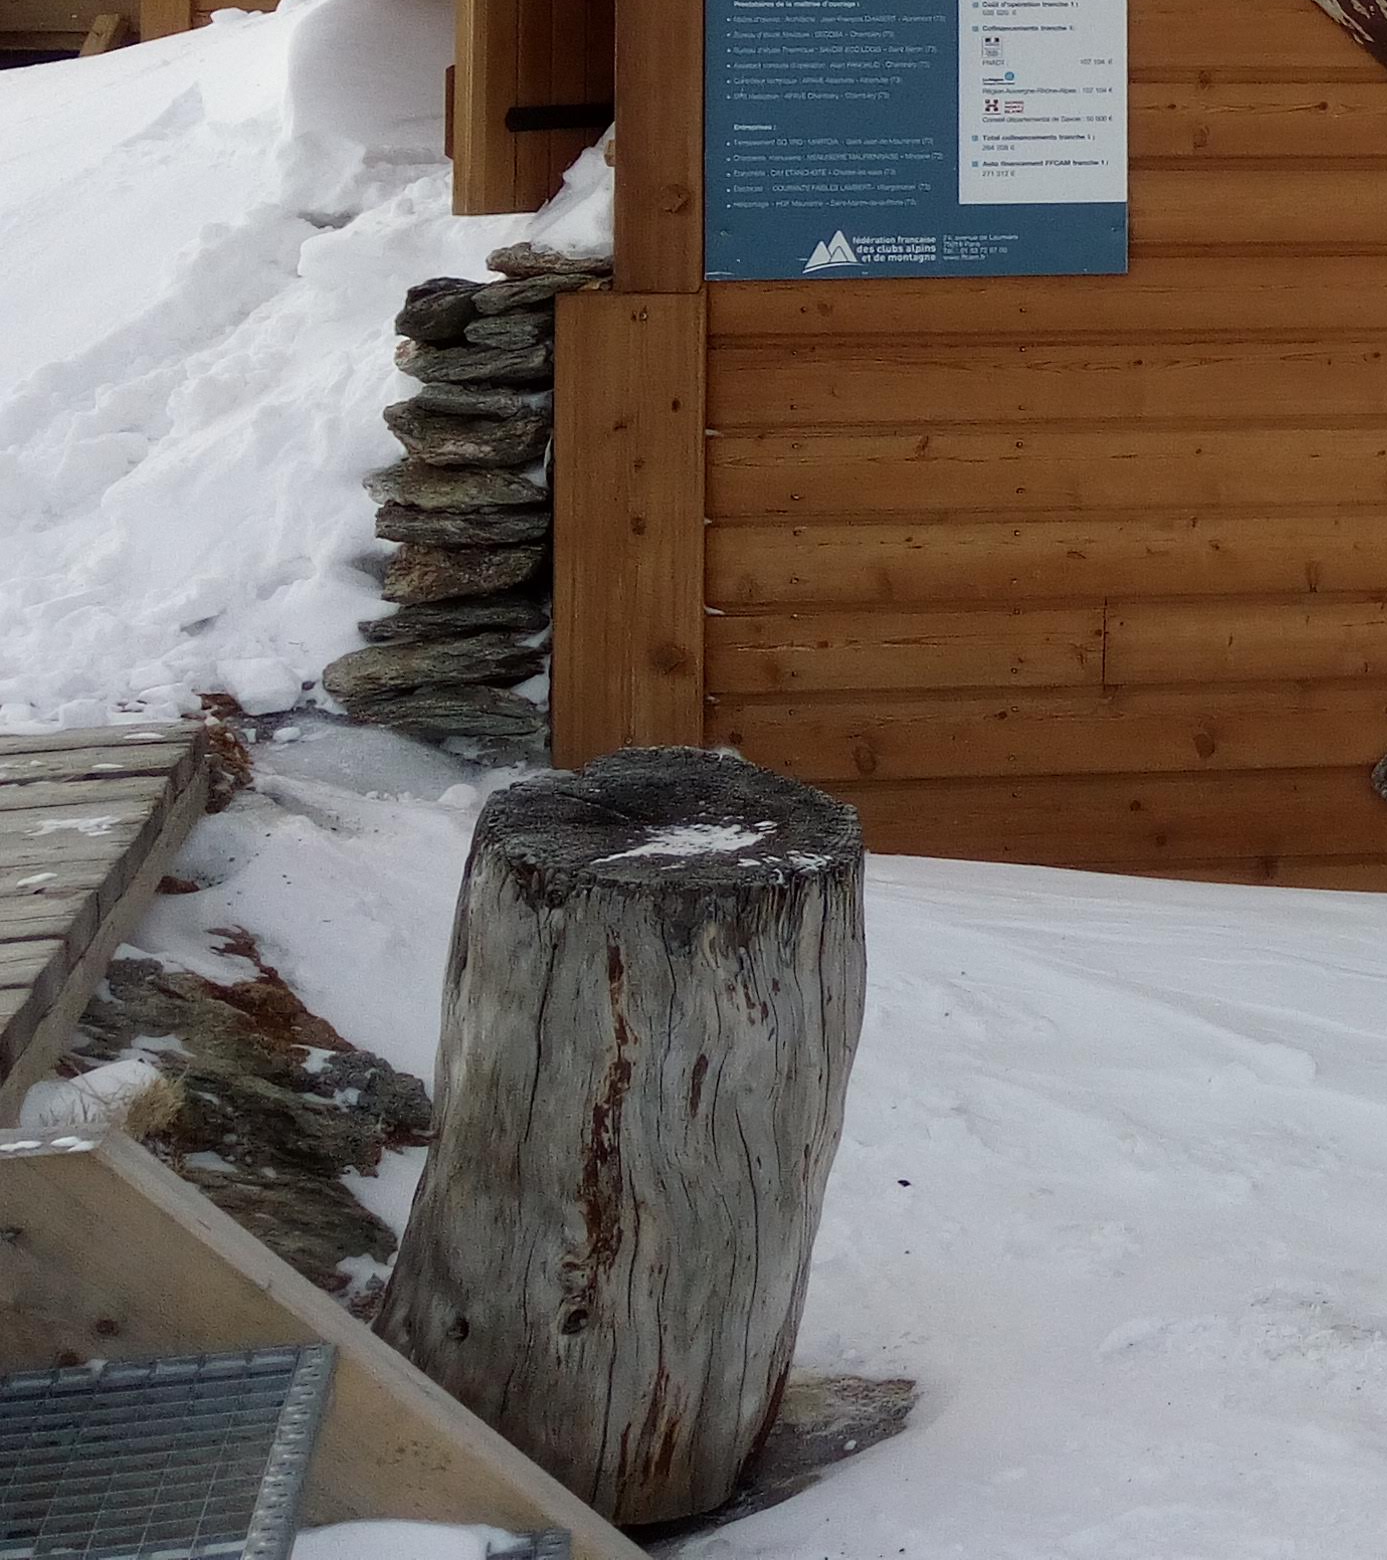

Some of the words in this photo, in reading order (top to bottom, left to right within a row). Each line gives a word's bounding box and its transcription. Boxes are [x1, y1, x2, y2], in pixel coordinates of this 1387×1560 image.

[856, 244, 875, 254] des
[876, 244, 904, 254] clubs
[905, 244, 937, 255] alpins
[861, 253, 872, 263] et
[873, 253, 886, 262] de
[887, 253, 937, 264] montagne
